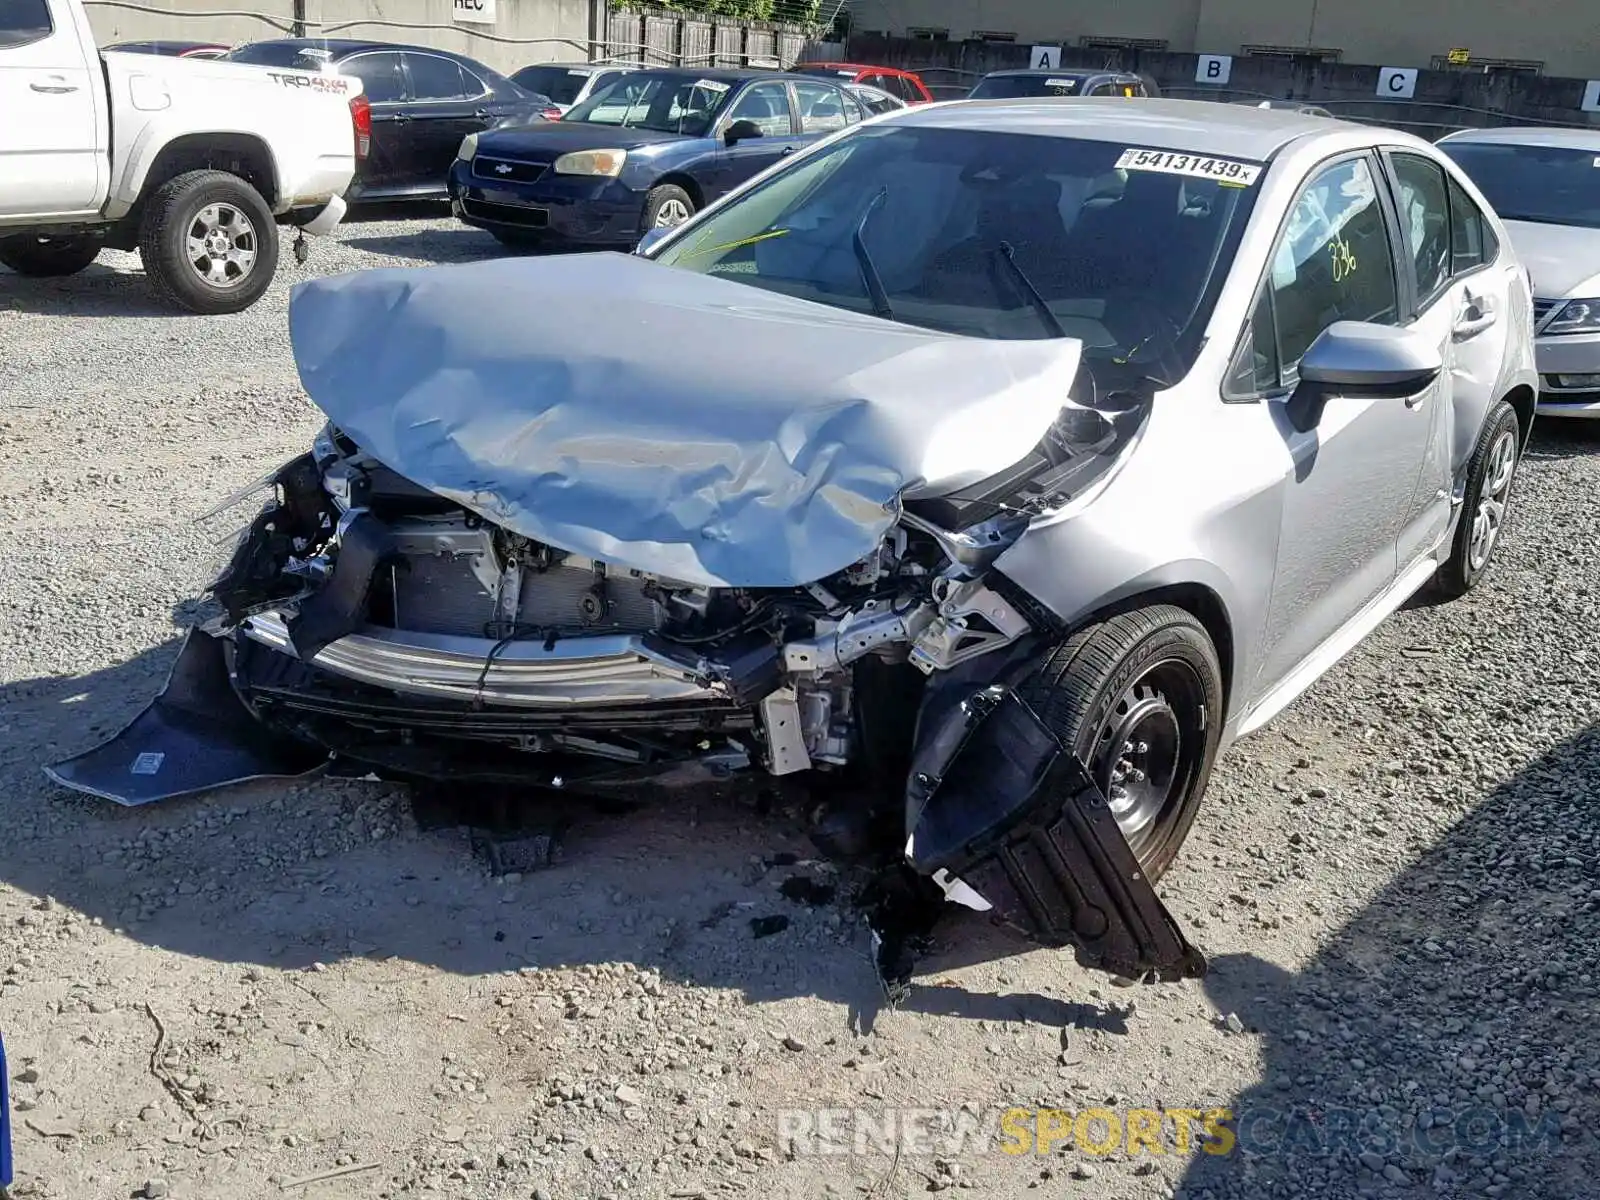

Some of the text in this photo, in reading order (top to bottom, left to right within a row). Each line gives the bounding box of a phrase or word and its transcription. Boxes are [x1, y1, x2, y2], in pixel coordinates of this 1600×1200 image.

[1038, 52, 1050, 68] A
[1207, 61, 1220, 78] B
[267, 72, 310, 88] TRD
[1389, 74, 1405, 92] C
